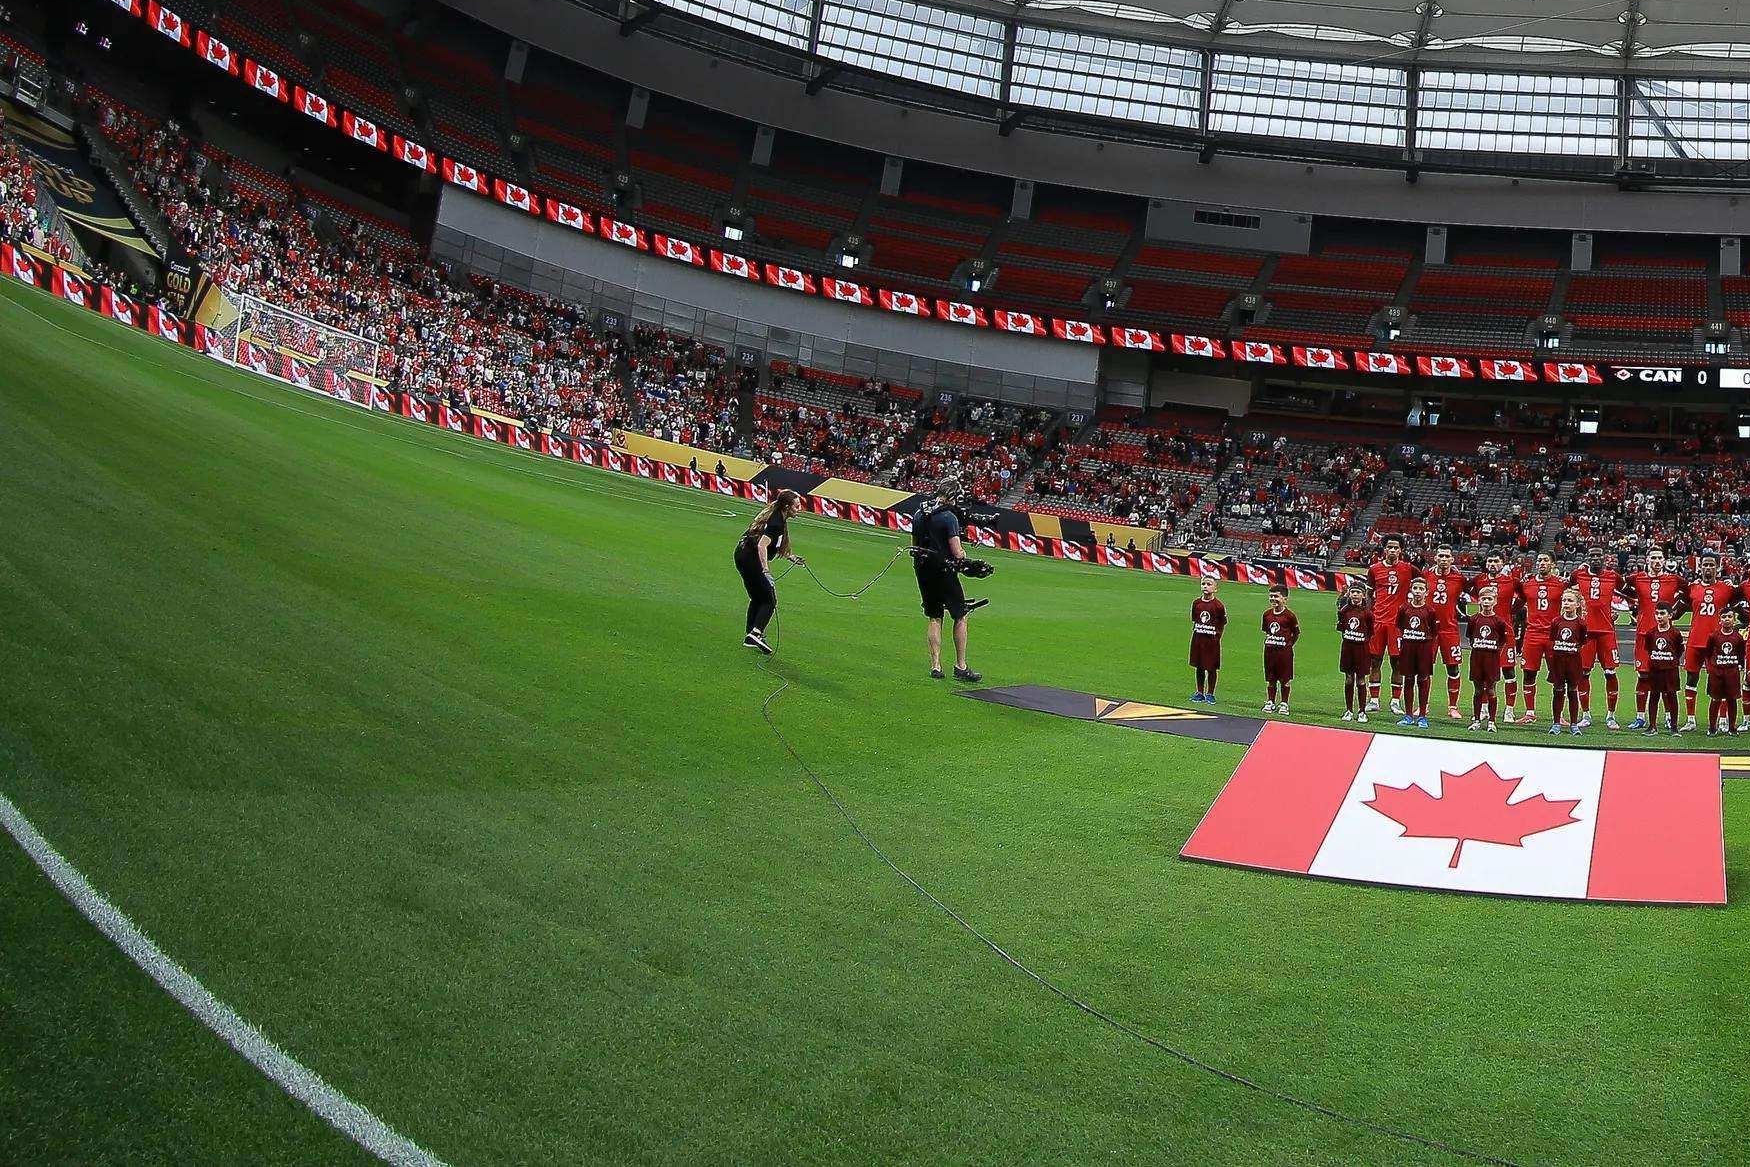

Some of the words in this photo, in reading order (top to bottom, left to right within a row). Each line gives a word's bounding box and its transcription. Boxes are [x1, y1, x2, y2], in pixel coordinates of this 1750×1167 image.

[166, 272, 190, 293] GOLD
[1710, 322, 1722, 330] 441
[1639, 370, 1682, 383] CAN
[1698, 370, 1707, 385] 0
[1402, 446, 1415, 454] 239
[1433, 592, 1448, 604] 23
[1590, 588, 1599, 600] 12
[1537, 598, 1548, 610] 19
[1700, 604, 1715, 616] 20
